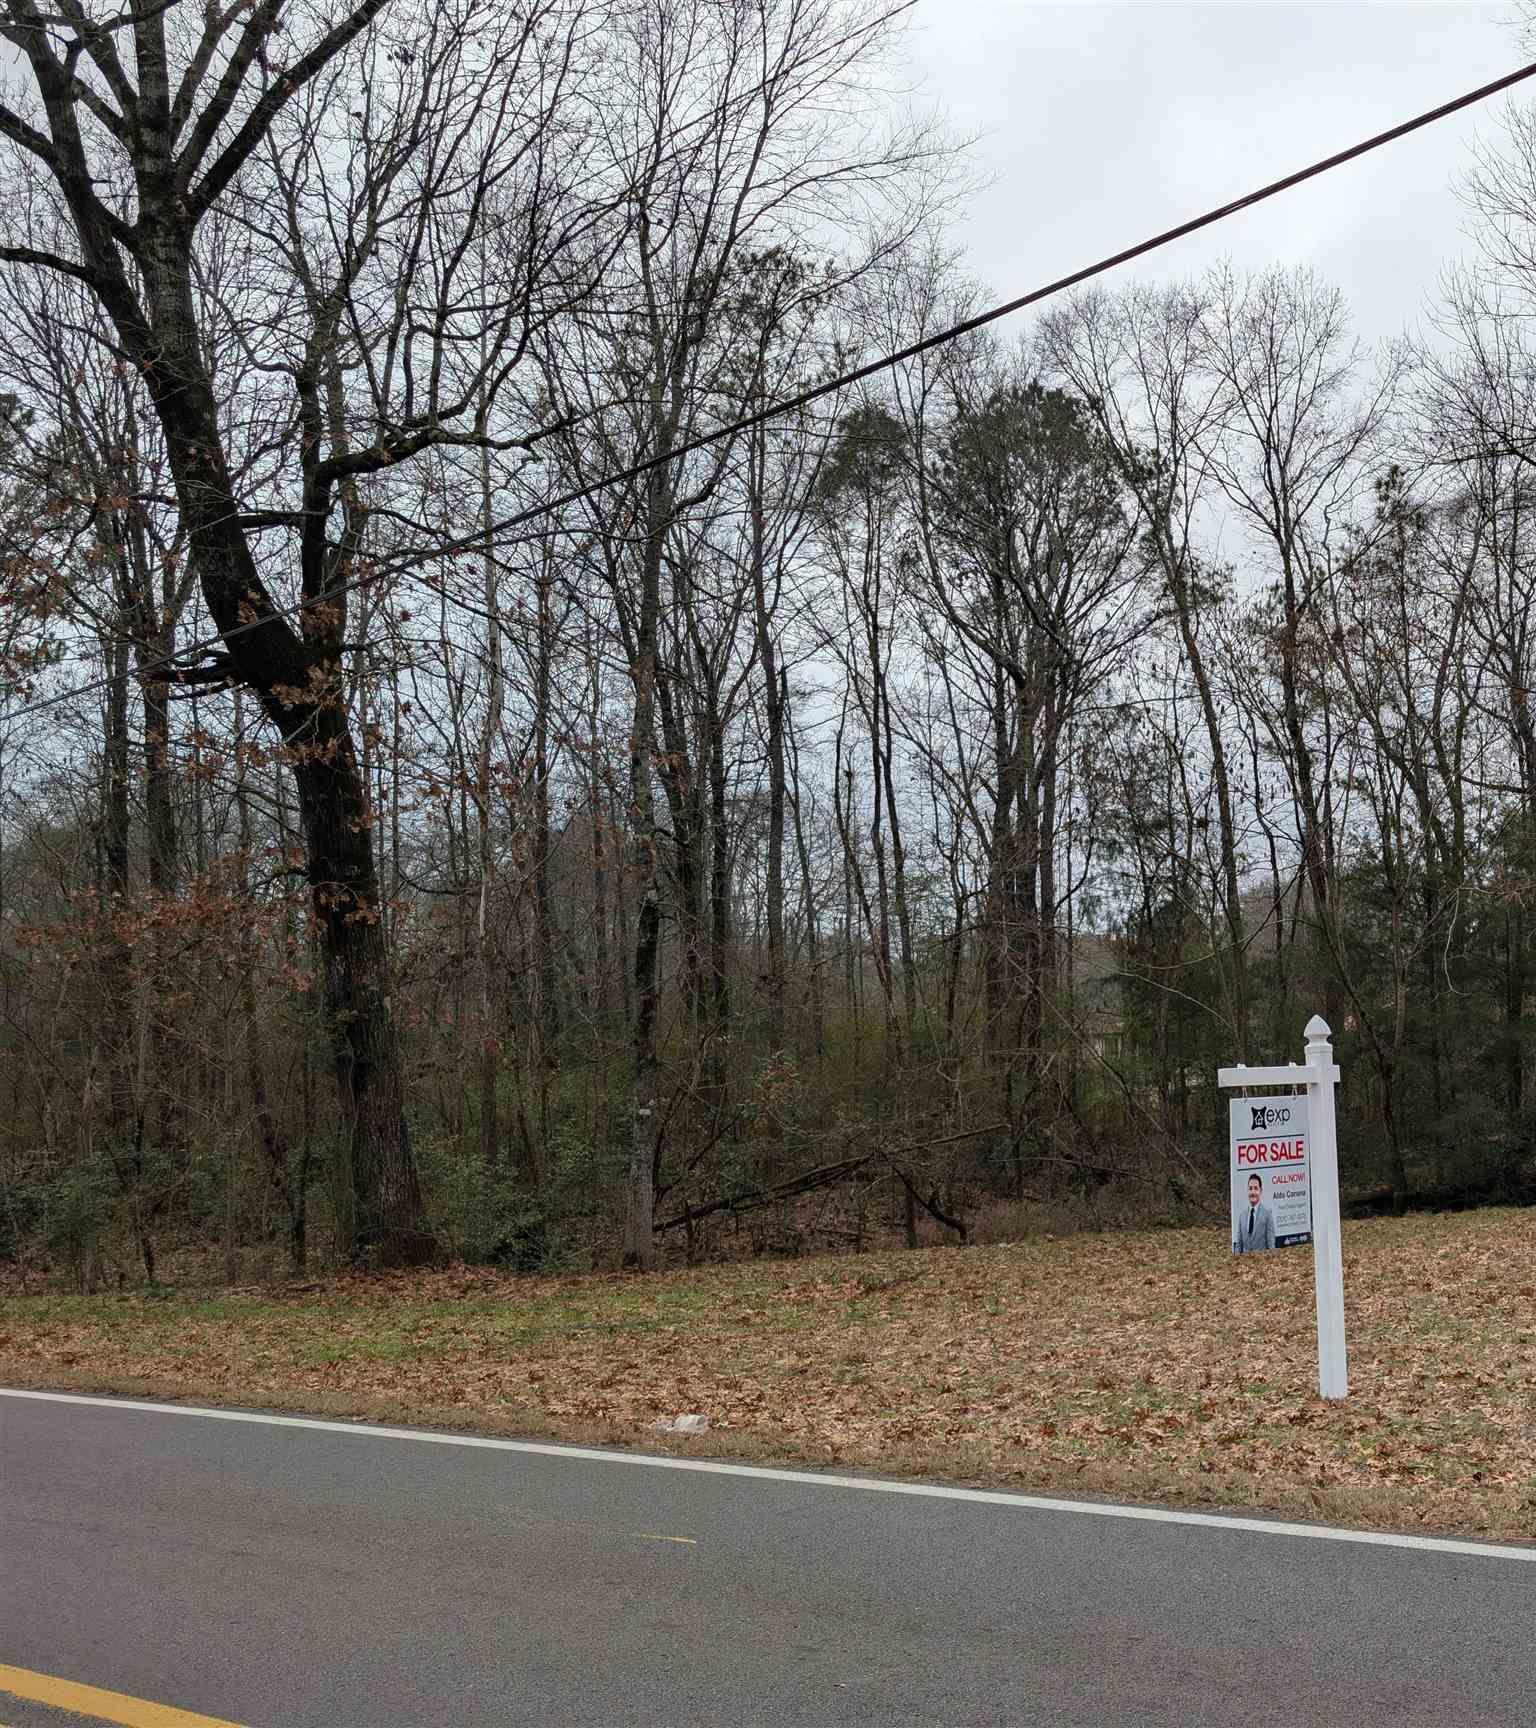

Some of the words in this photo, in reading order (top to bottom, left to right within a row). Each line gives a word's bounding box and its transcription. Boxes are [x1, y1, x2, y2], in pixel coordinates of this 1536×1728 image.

[1266, 1108, 1291, 1125] exp
[1237, 1143, 1267, 1165] FOR
[1270, 1140, 1304, 1161] SALE
[1272, 1175, 1288, 1184] CALL
